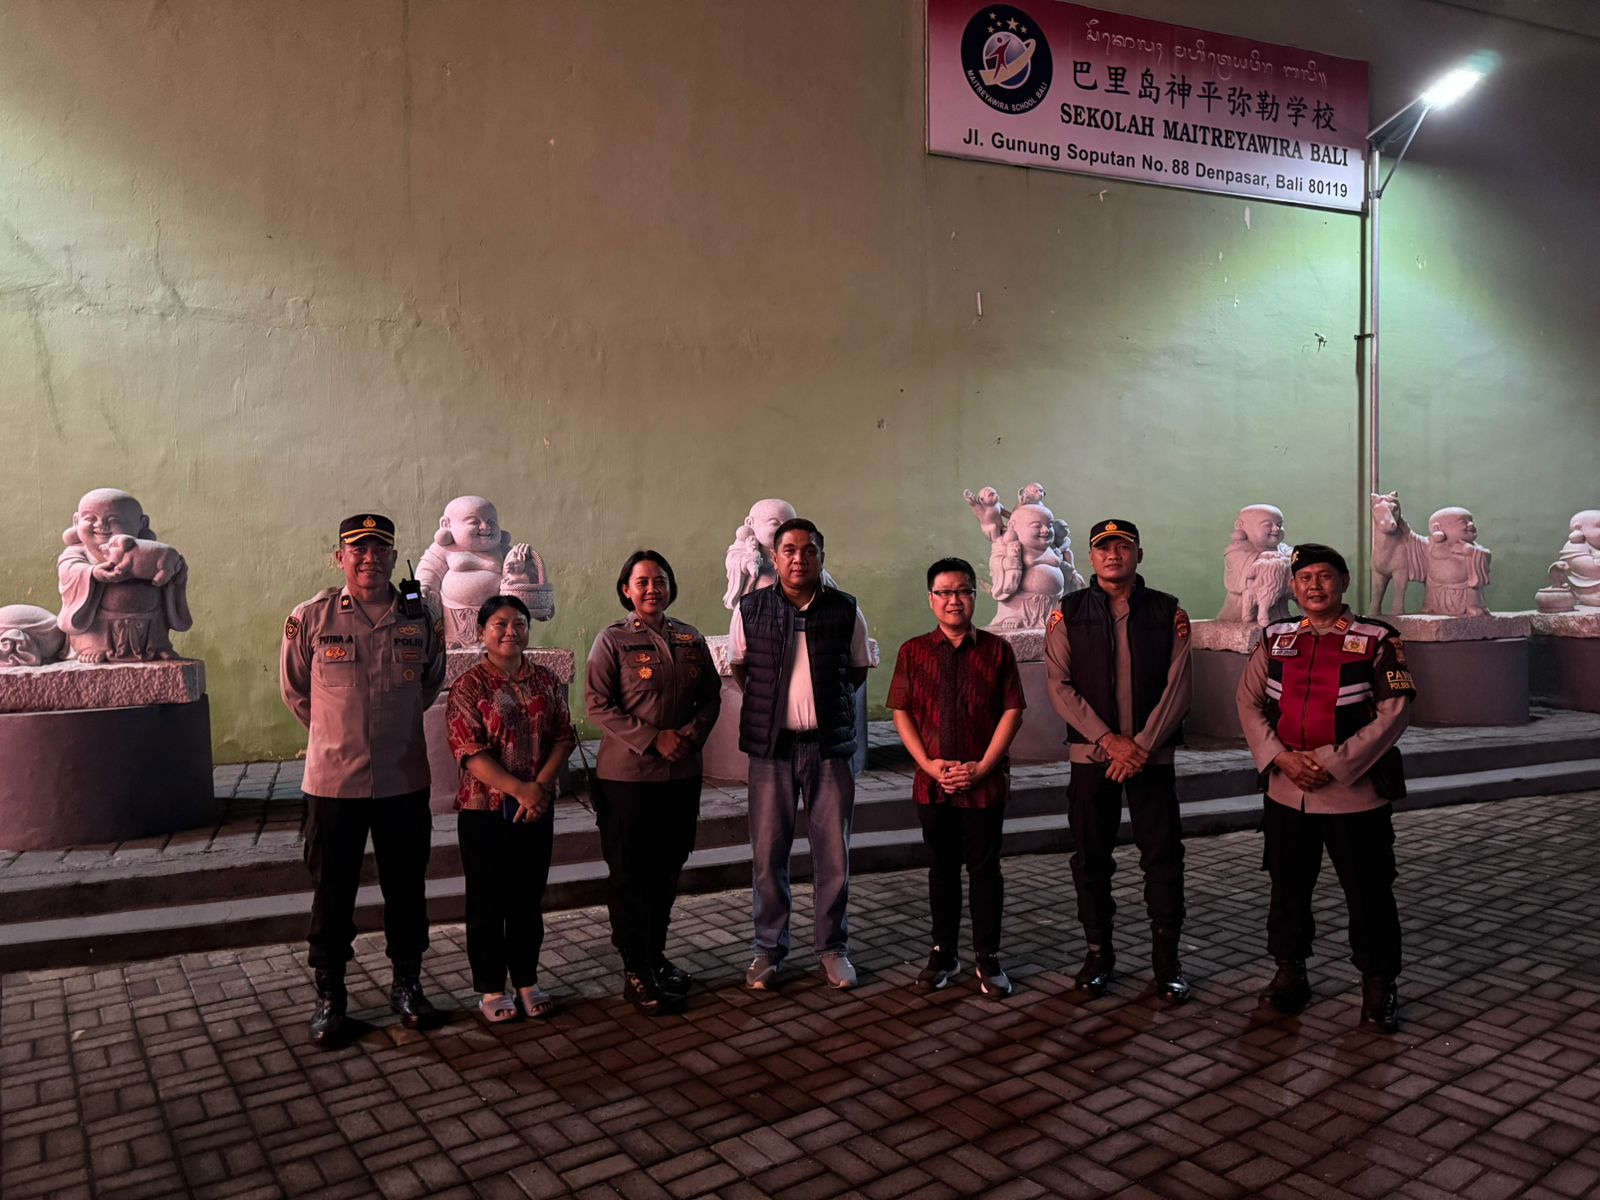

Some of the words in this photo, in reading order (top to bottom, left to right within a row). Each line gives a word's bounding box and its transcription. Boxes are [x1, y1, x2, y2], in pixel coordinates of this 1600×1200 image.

[967, 69, 1009, 111] MAITREYAWIRA
[1011, 97, 1037, 112] SCHOOL
[1035, 81, 1048, 99] BALI
[1073, 60, 1338, 132] 巴里岛神平弥勒学校
[963, 128, 984, 146] Jl.
[991, 132, 1060, 161] Gunung
[1067, 143, 1135, 168] Soputan
[1142, 155, 1168, 173] No.
[1172, 159, 1189, 175] 88
[1196, 162, 1270, 189] Denpasar,
[1276, 174, 1303, 192] Bali
[1308, 179, 1348, 197] 80119
[1060, 102, 1154, 137] SEKOLAH
[1163, 120, 1303, 160] MAITREYAWIRA
[1310, 143, 1348, 166] BALI
